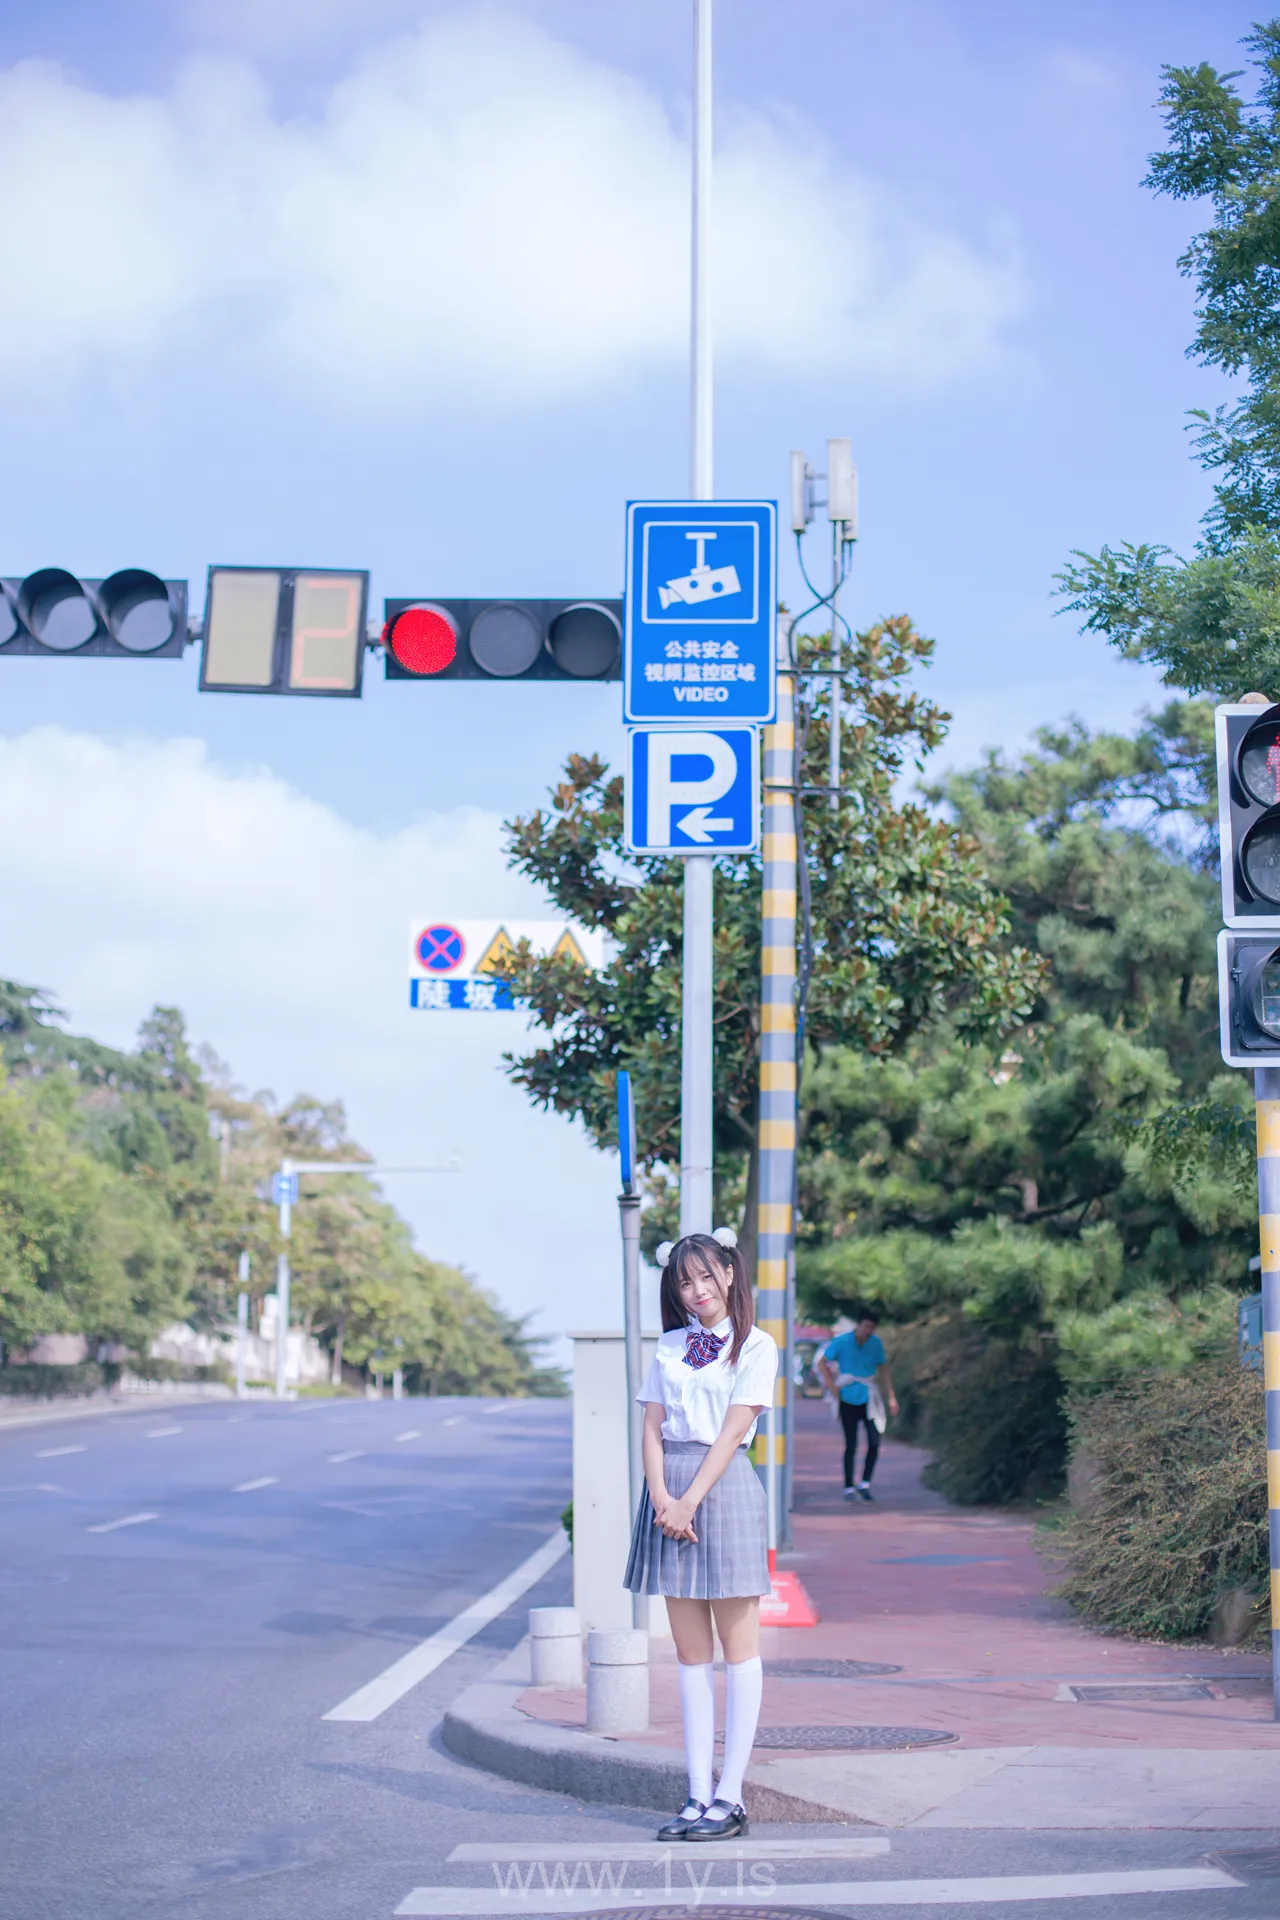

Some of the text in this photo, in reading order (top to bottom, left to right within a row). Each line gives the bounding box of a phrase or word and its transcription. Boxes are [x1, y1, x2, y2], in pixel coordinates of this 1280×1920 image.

[664, 640, 740, 659] 公共安全
[644, 662, 756, 682] 视频监控区域
[673, 686, 729, 702] VIDEO
[646, 731, 738, 847] P
